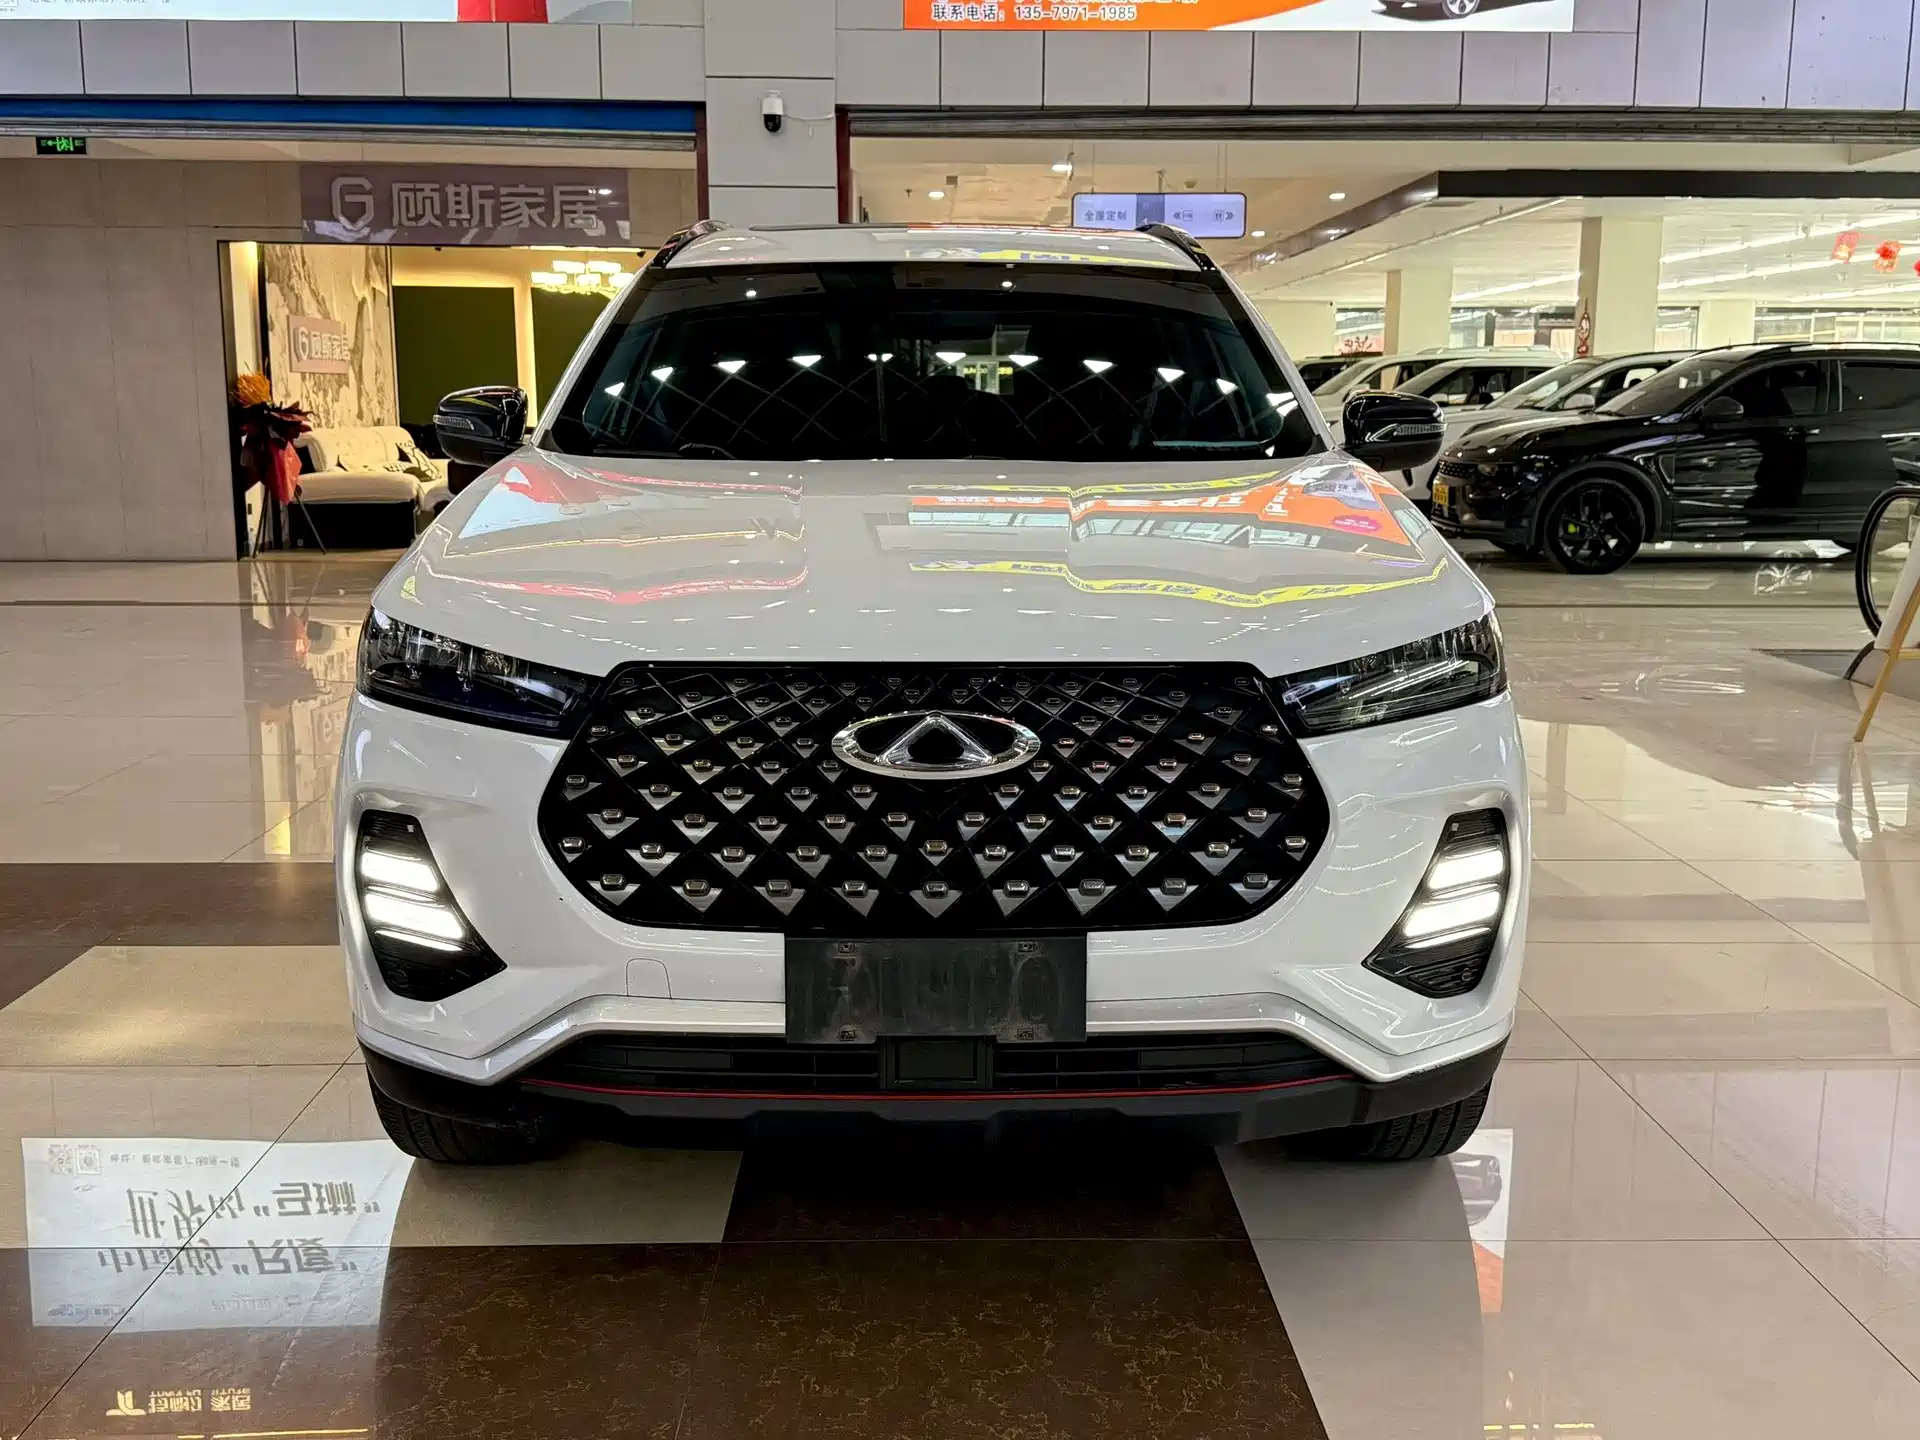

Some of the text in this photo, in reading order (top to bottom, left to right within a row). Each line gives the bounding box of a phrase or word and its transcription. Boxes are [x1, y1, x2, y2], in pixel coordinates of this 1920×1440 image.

[931, 4, 1136, 22] 联系电话： 135-7971-1985
[392, 182, 598, 229] 顾斯家居
